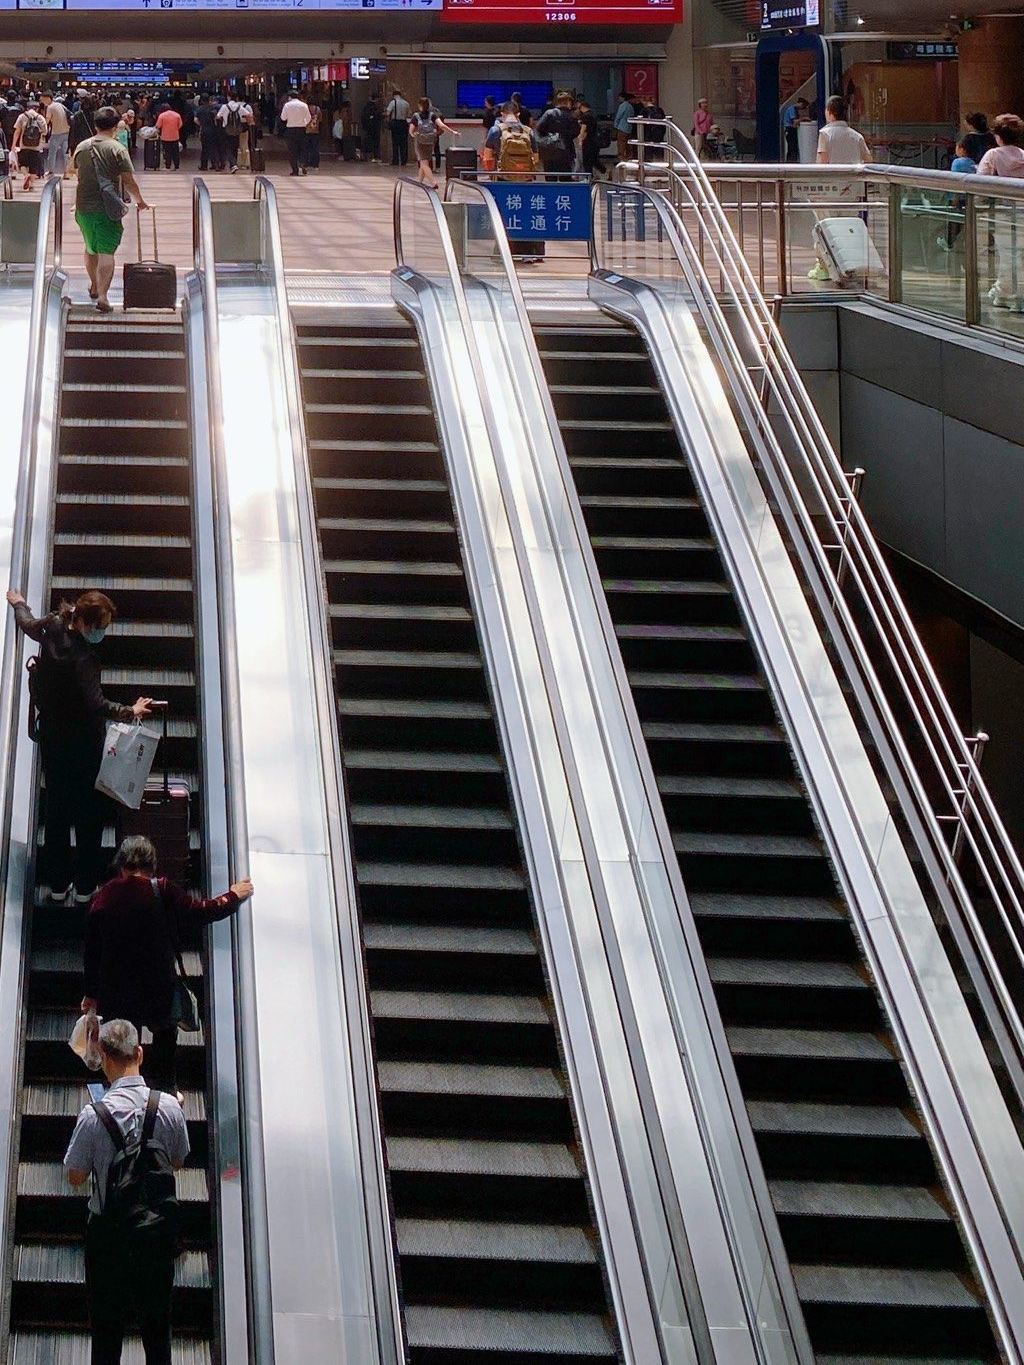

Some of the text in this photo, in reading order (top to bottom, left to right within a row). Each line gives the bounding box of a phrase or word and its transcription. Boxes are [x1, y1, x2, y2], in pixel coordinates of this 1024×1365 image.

[546, 13, 576, 21] 12306
[916, 44, 958, 54] 母婴候车
